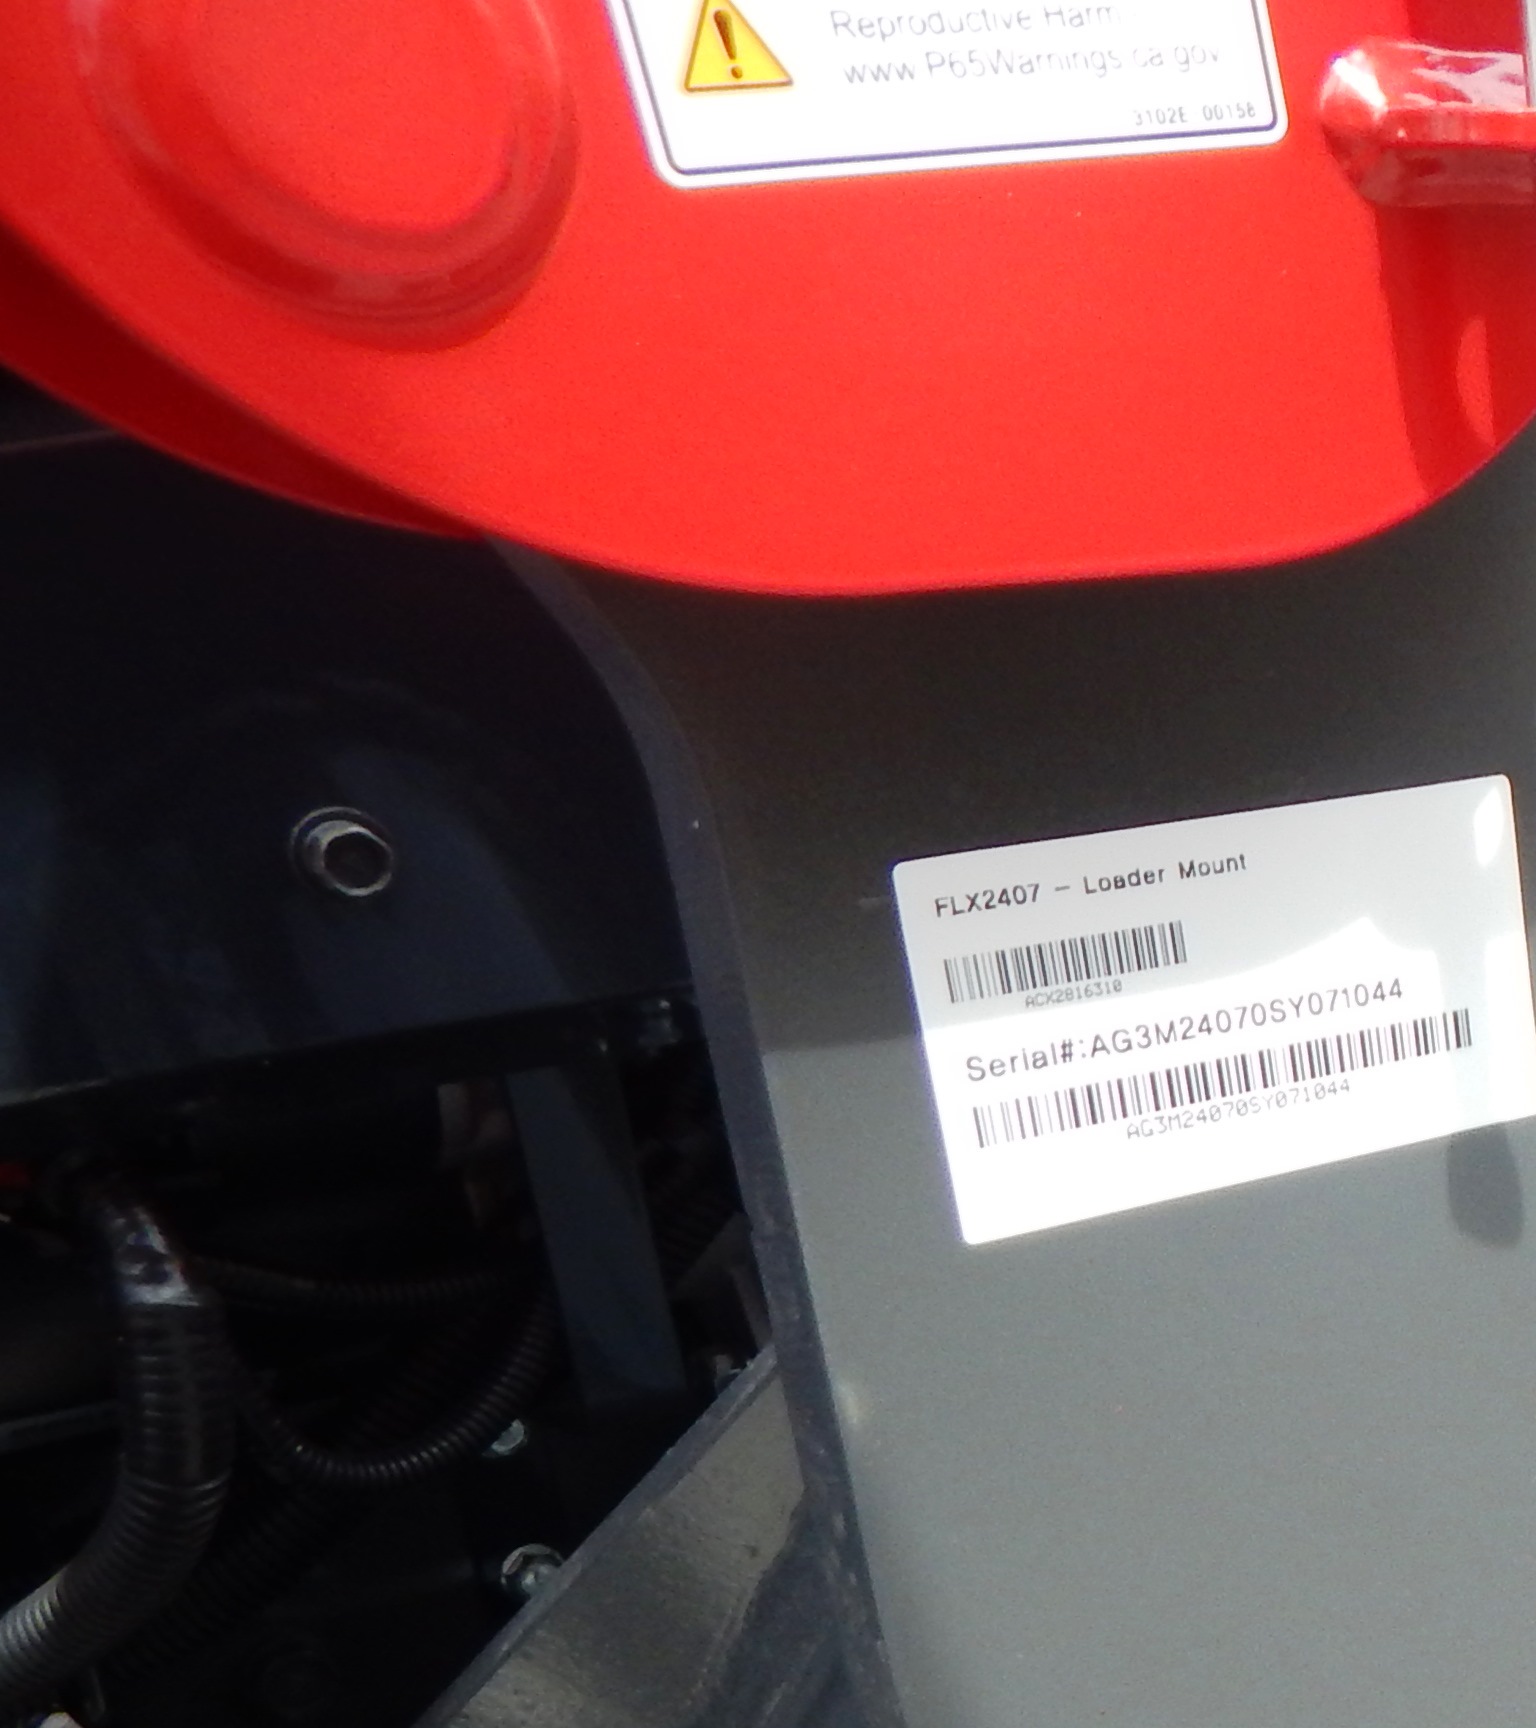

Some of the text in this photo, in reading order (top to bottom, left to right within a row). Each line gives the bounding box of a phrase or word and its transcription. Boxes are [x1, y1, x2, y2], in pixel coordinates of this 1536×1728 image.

[830, 8, 1032, 42] Reproductive
[844, 45, 1221, 84] wwwP65Warningscagov
[934, 882, 1041, 919] FLX2407
[1083, 864, 1165, 897] Loader
[1178, 853, 1248, 880] Mount
[1126, 1079, 1351, 1139] AG3M24070SY071044
